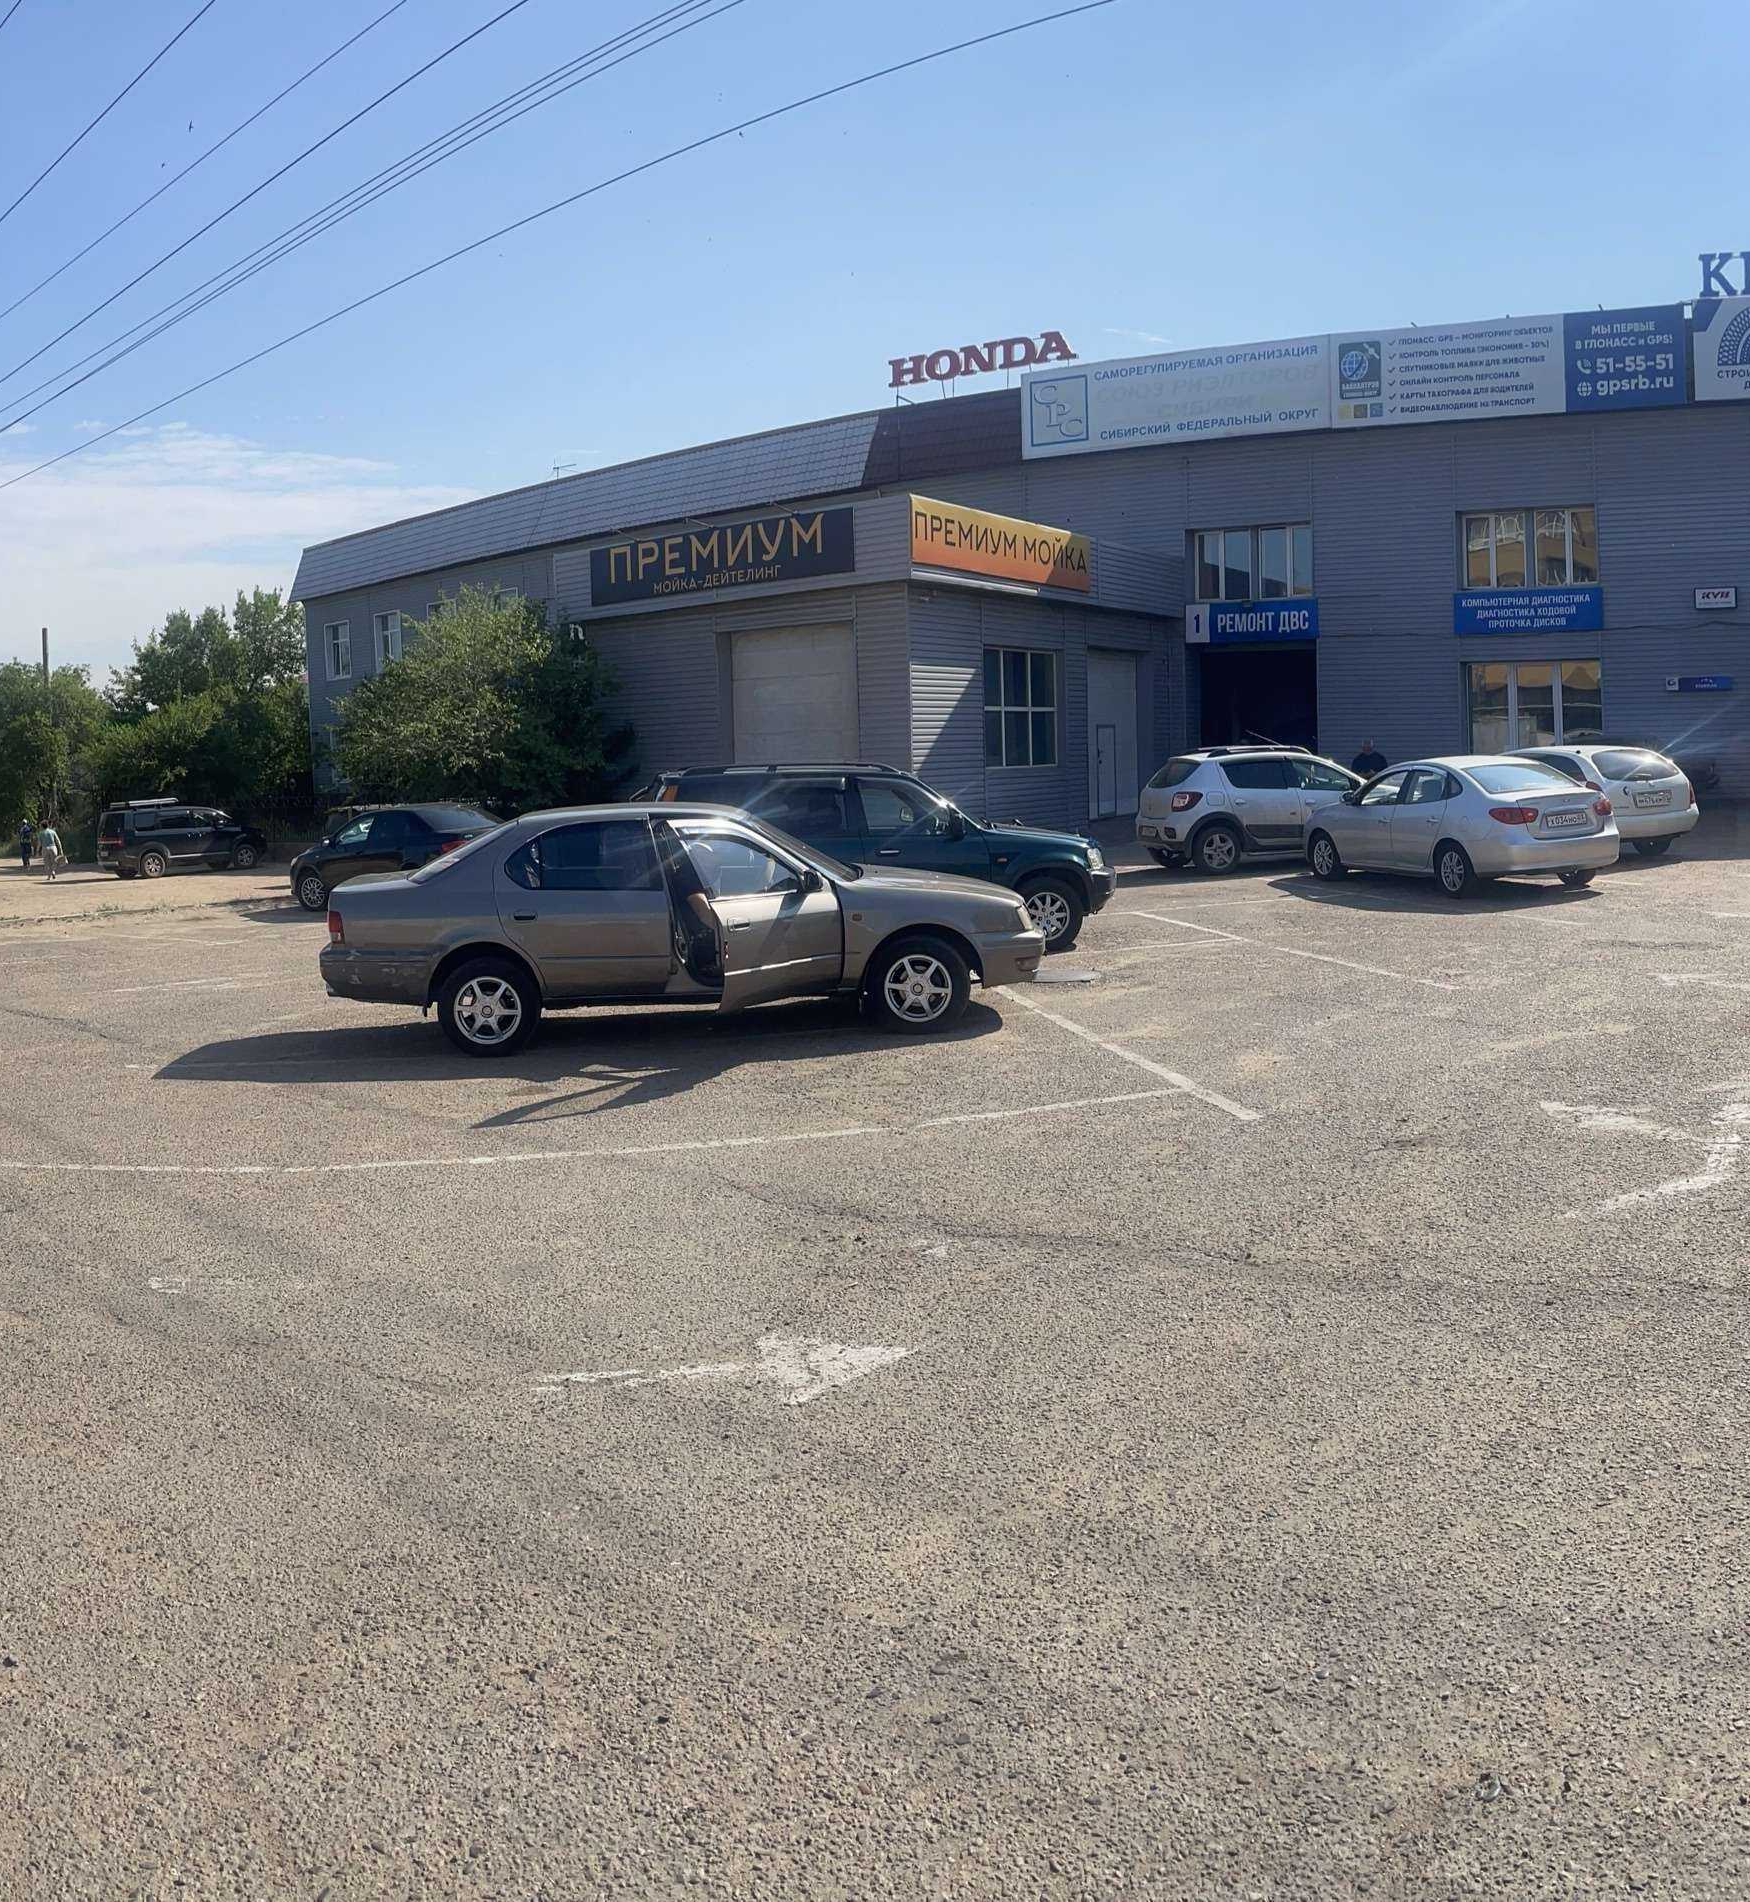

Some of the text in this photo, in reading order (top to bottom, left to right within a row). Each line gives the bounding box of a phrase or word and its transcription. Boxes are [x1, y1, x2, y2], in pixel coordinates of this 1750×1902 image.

[1591, 321, 1655, 335] МЫ ПЕРВЫЕ
[1575, 340, 1582, 349] В
[1584, 337, 1636, 349] ГЛОНАСС
[1647, 334, 1673, 345] GPS!
[888, 331, 1079, 388] HONDA
[1094, 345, 1318, 381] САМОРЕГУЛИРУЕМАЯ ОРГАНИЗАЦИЯ
[1596, 353, 1674, 374] 51-55-51
[1596, 374, 1674, 396] gpsrb.ru
[1490, 398, 1535, 408] ТРАНСПОРТ
[1100, 408, 1319, 441] СИБИРСКИЙ ФЕДЕРАЛЬНЫЙ ОКРУГ
[609, 513, 825, 584] ПРЕМИУМ
[914, 511, 1087, 573] ПРЕМИУМ МОЙКА
[653, 565, 782, 594] МОЙКА-ДЕЙТЕЛИНГ
[1461, 594, 1590, 608] КОМПЬЮТЕРНАЯ ДИАГНОСТИКА
[1217, 610, 1309, 633] РЕМОНТ ДВС
[1477, 605, 1576, 619] ДИАГНОСТИКА ХОДОВОЙ
[1194, 613, 1200, 634] 1
[1488, 617, 1566, 629] ПРОТОЧКА ДИСКОВ
